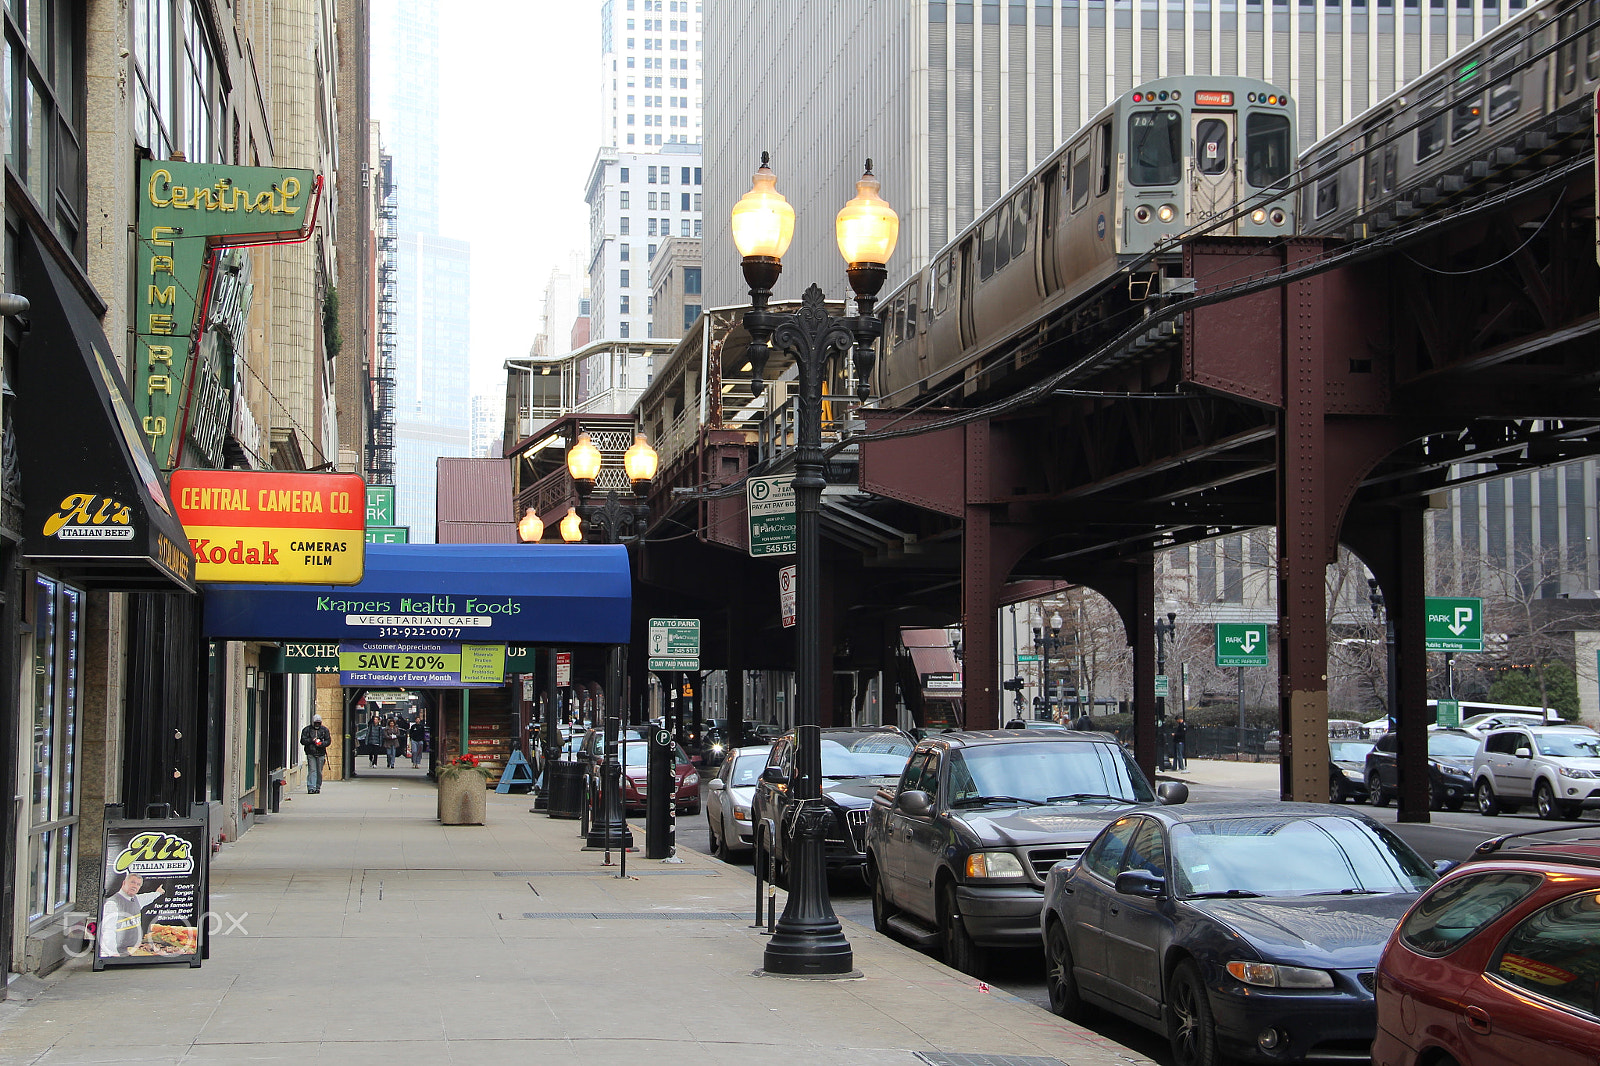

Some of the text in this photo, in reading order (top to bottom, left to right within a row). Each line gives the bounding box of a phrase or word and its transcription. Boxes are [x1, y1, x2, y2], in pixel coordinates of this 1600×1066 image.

[1197, 94, 1220, 102] Midway
[148, 168, 301, 214] Central
[181, 488, 353, 514] CENTRAL CAMERA CO.
[752, 503, 763, 511] PAY
[763, 502, 771, 510] AT
[772, 501, 784, 509] PAY
[42, 493, 132, 537] Al's
[62, 528, 131, 537] ITALIAN BEEF
[188, 539, 279, 565] Kodak
[290, 541, 347, 552] CAMERAS
[765, 543, 796, 553] 545 513
[304, 555, 332, 566] FILM
[316, 595, 521, 616] Kramers Health Foods
[359, 616, 480, 626] VEGETARIAN CAFE
[379, 627, 461, 638] 312-922-0077
[362, 642, 441, 652] Customer Appreciation
[357, 654, 445, 670] SAVE 20%
[350, 673, 452, 683] First Tuesday of Every Month
[117, 835, 188, 870] Al's
